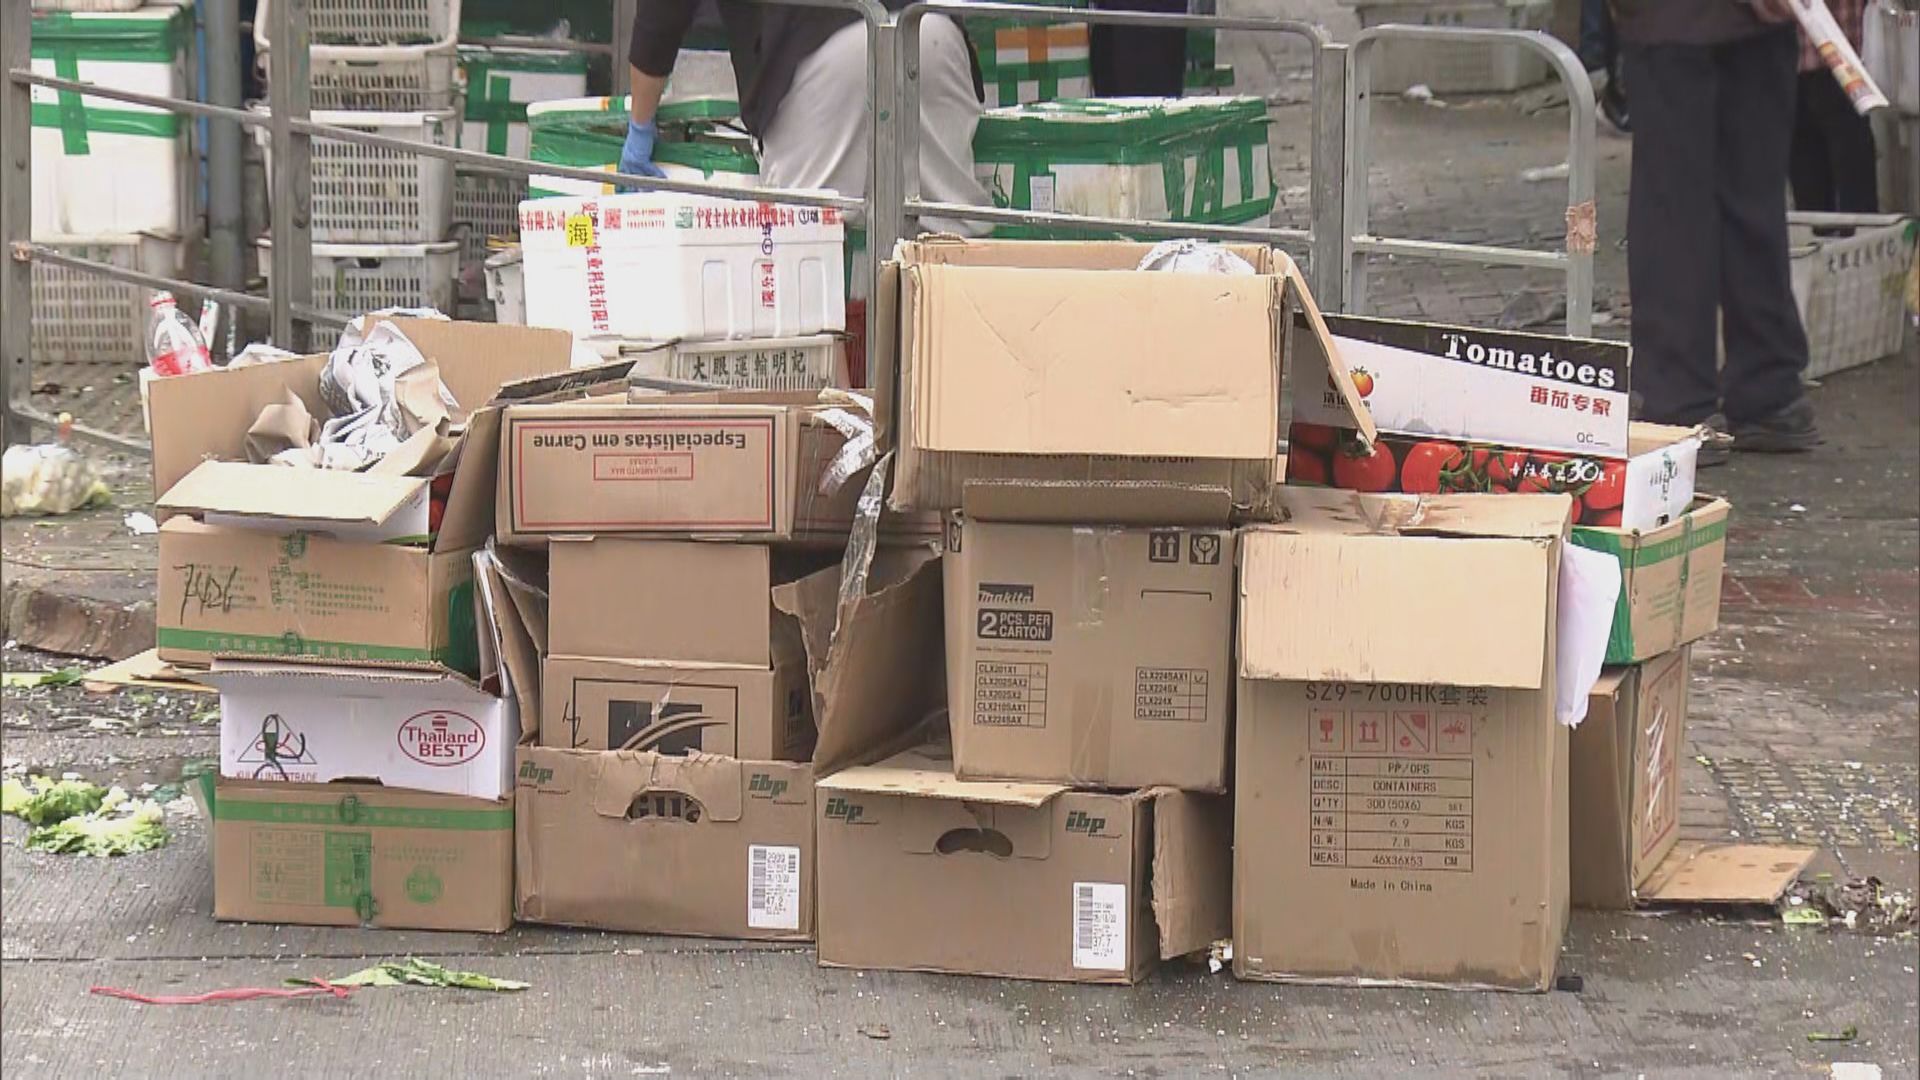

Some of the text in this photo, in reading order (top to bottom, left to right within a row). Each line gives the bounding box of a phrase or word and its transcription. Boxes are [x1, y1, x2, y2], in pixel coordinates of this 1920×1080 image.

[568, 222, 588, 245] 海
[692, 349, 806, 380] 大眼運輸明記
[1442, 333, 1616, 388] Tomatoes
[1530, 385, 1612, 417] 番茄专家
[533, 429, 746, 451] Especialistas em Carne
[977, 590, 1033, 604] makita
[981, 612, 998, 636] 2
[1000, 611, 1051, 627] PCS. PER
[999, 625, 1047, 640] CARTON
[405, 726, 478, 743] Thailand
[419, 743, 468, 757] BEST
[519, 760, 554, 784] ibp
[749, 774, 788, 797] ibp
[1373, 780, 1437, 793] CONTAINERS
[825, 798, 864, 821] ibp
[1065, 811, 1106, 833] ibp
[1445, 819, 1465, 829] KGS
[1445, 838, 1465, 849] KGS
[1350, 877, 1432, 892] Made in China
